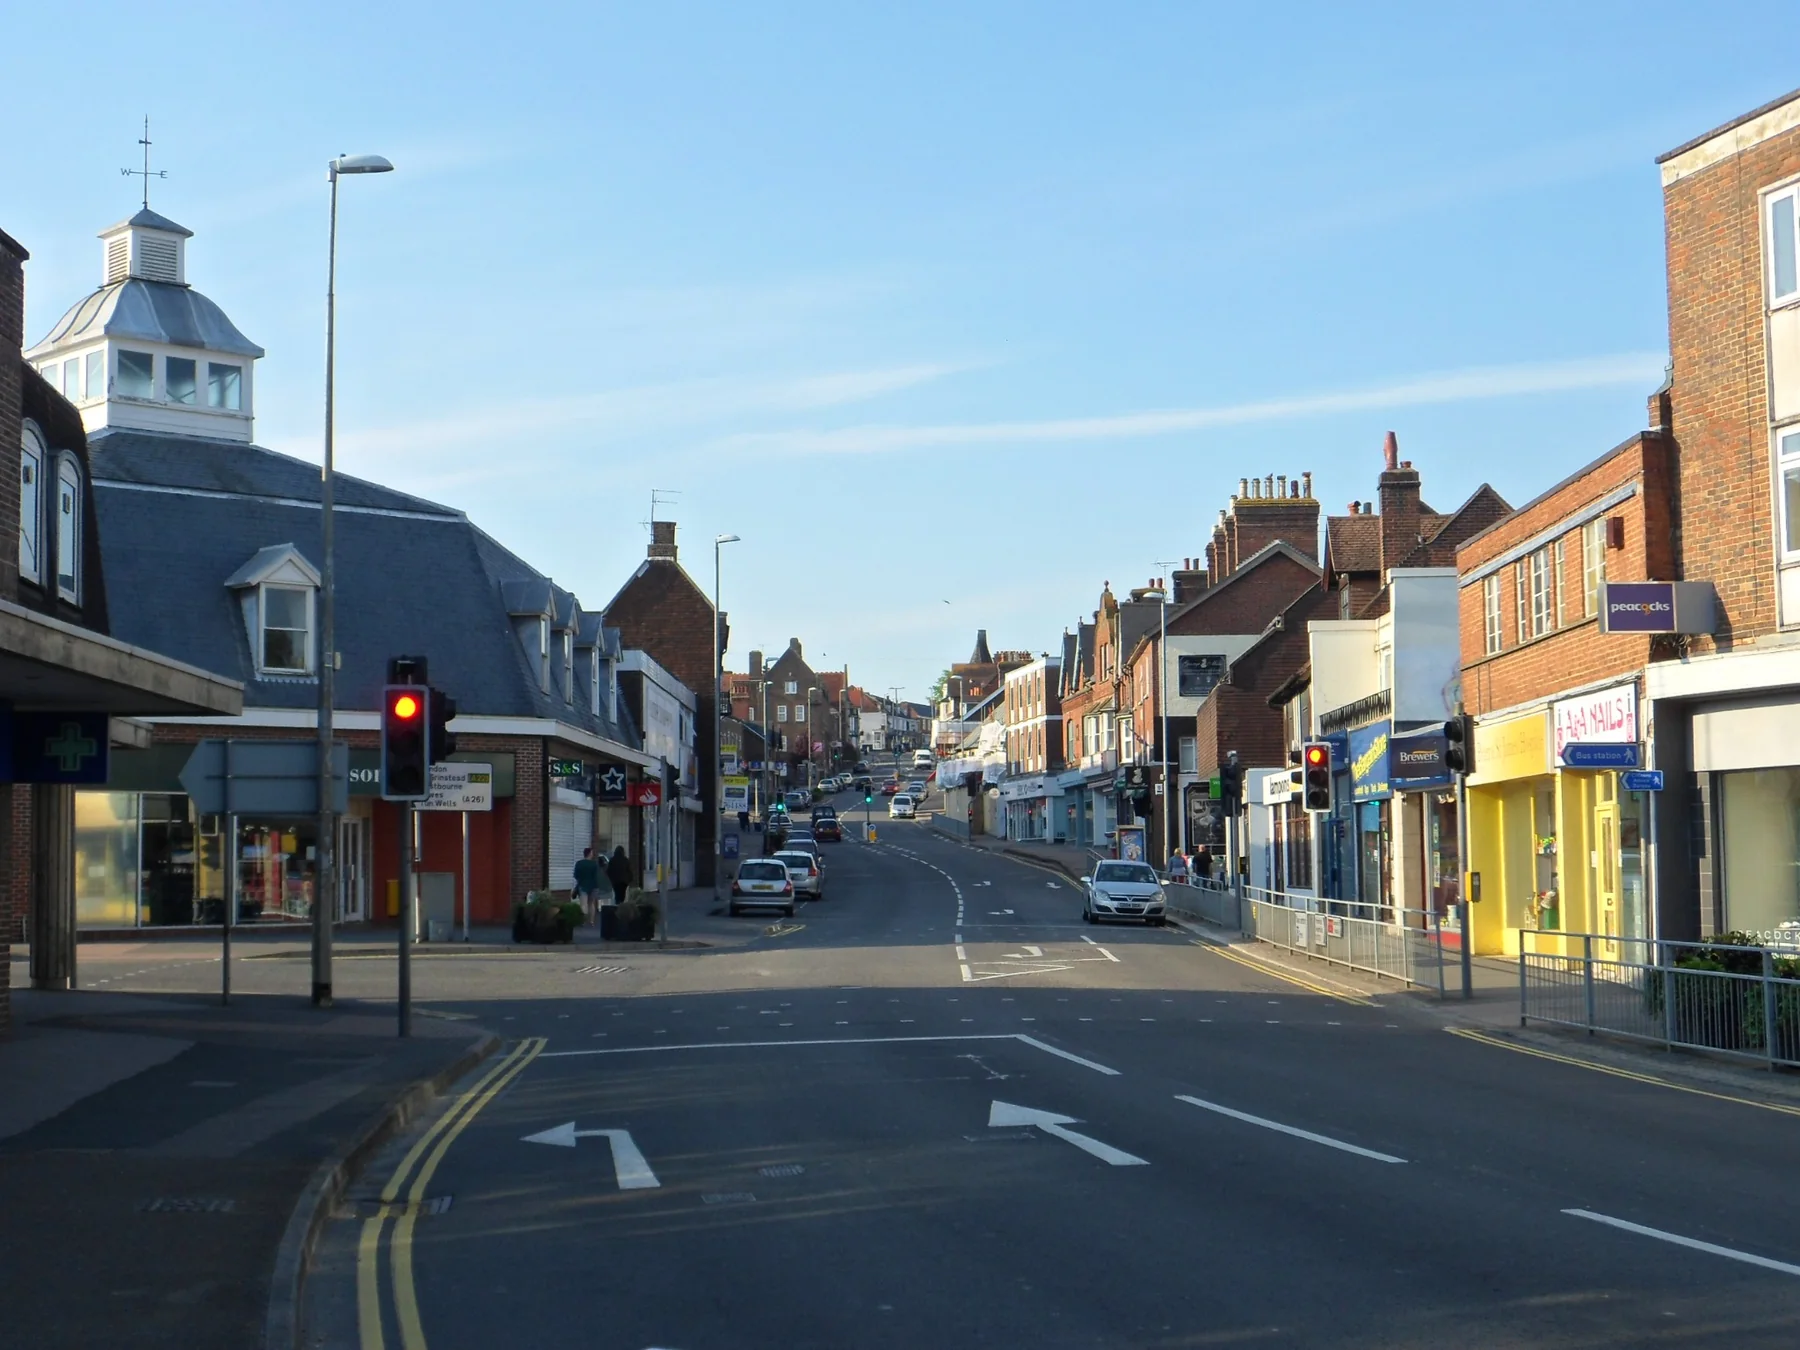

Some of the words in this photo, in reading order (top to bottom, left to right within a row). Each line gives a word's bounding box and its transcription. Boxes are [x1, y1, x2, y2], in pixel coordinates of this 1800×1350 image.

[121, 168, 131, 176] W
[1610, 601, 1670, 615] peacocks
[1590, 698, 1624, 736] NAILS
[1400, 751, 1439, 762] Brewers
[1576, 751, 1591, 760] Bus
[1593, 751, 1622, 760] station
[552, 762, 580, 774] S&S
